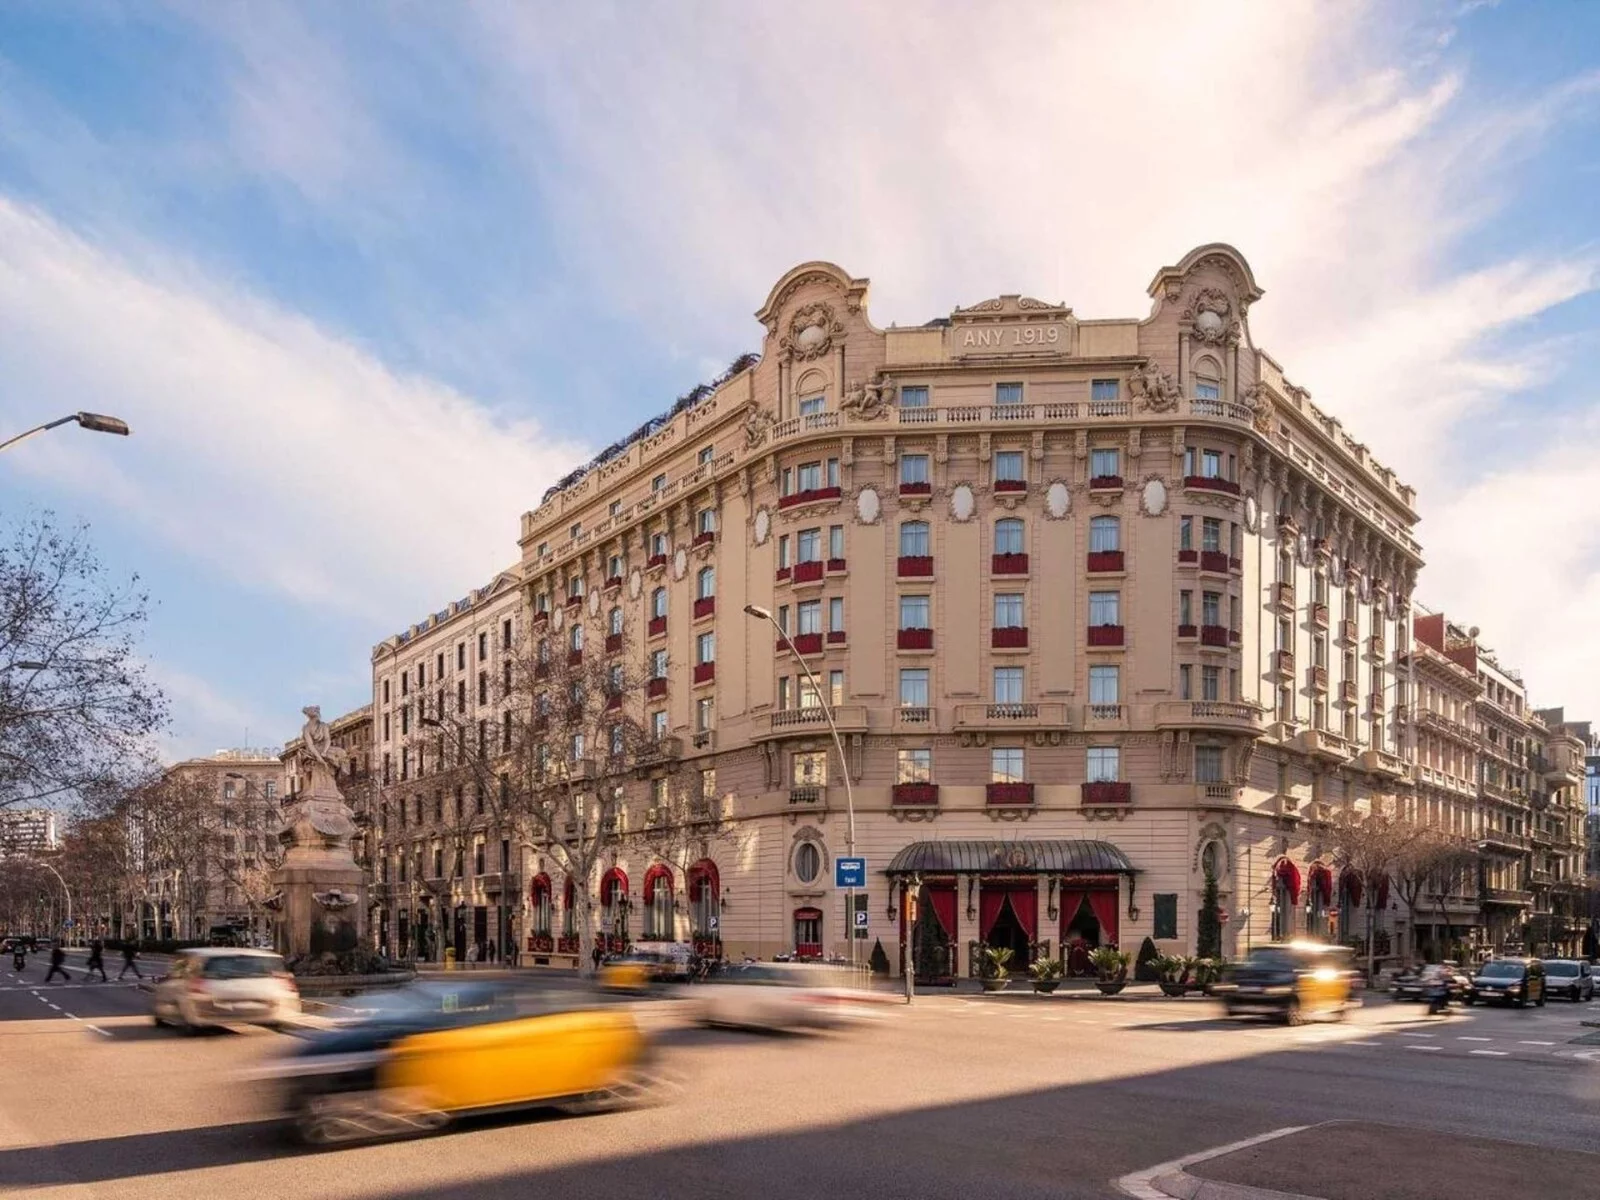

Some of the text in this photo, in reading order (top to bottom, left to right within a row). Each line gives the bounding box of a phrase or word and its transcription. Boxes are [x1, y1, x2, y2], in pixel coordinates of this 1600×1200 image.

[963, 327, 1058, 347] ANY 1919
[711, 918, 717, 927] P
[856, 913, 866, 925] P
